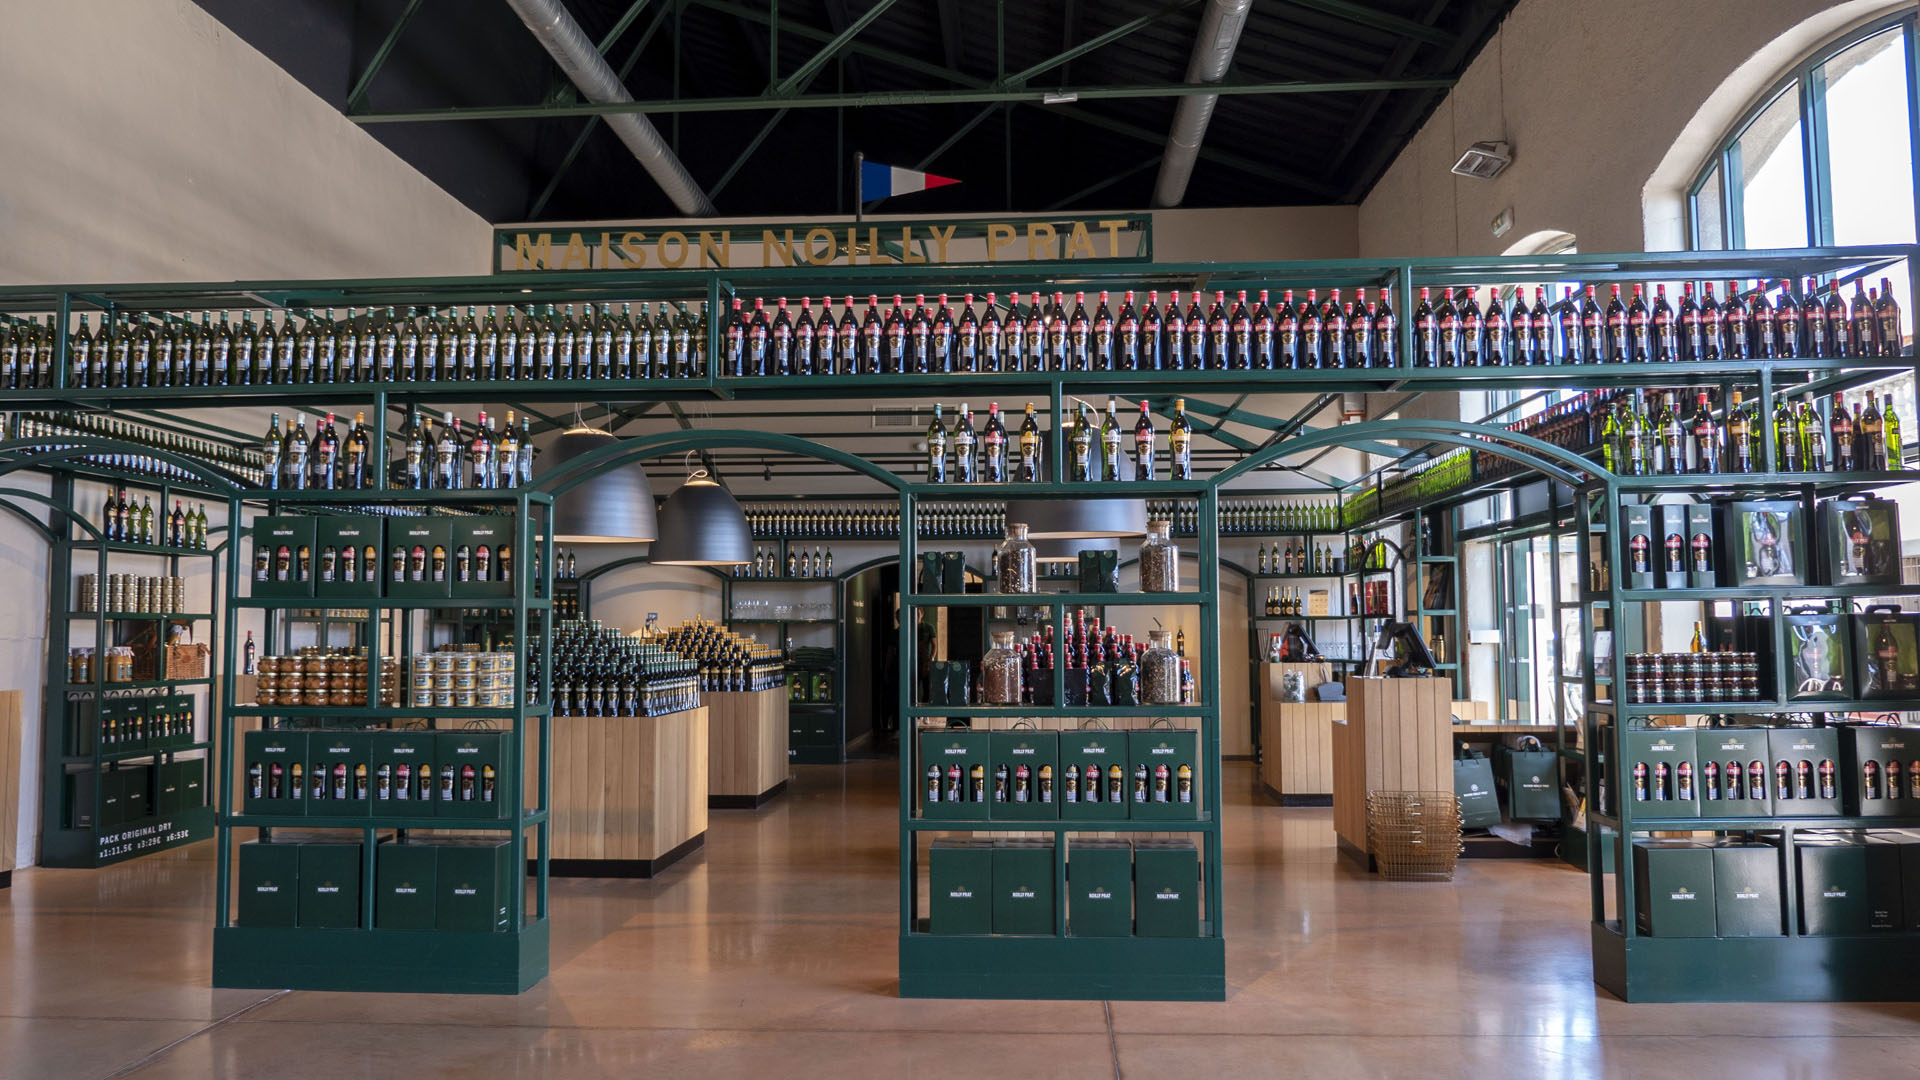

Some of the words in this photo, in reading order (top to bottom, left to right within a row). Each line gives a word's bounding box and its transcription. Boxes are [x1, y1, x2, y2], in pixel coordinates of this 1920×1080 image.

[515, 231, 731, 271] MAISON
[763, 225, 957, 267] NOILLY
[986, 219, 1130, 261] PRAT
[100, 834, 120, 845] PACK
[121, 826, 156, 840] ORIGINAL
[158, 822, 172, 832] DRY
